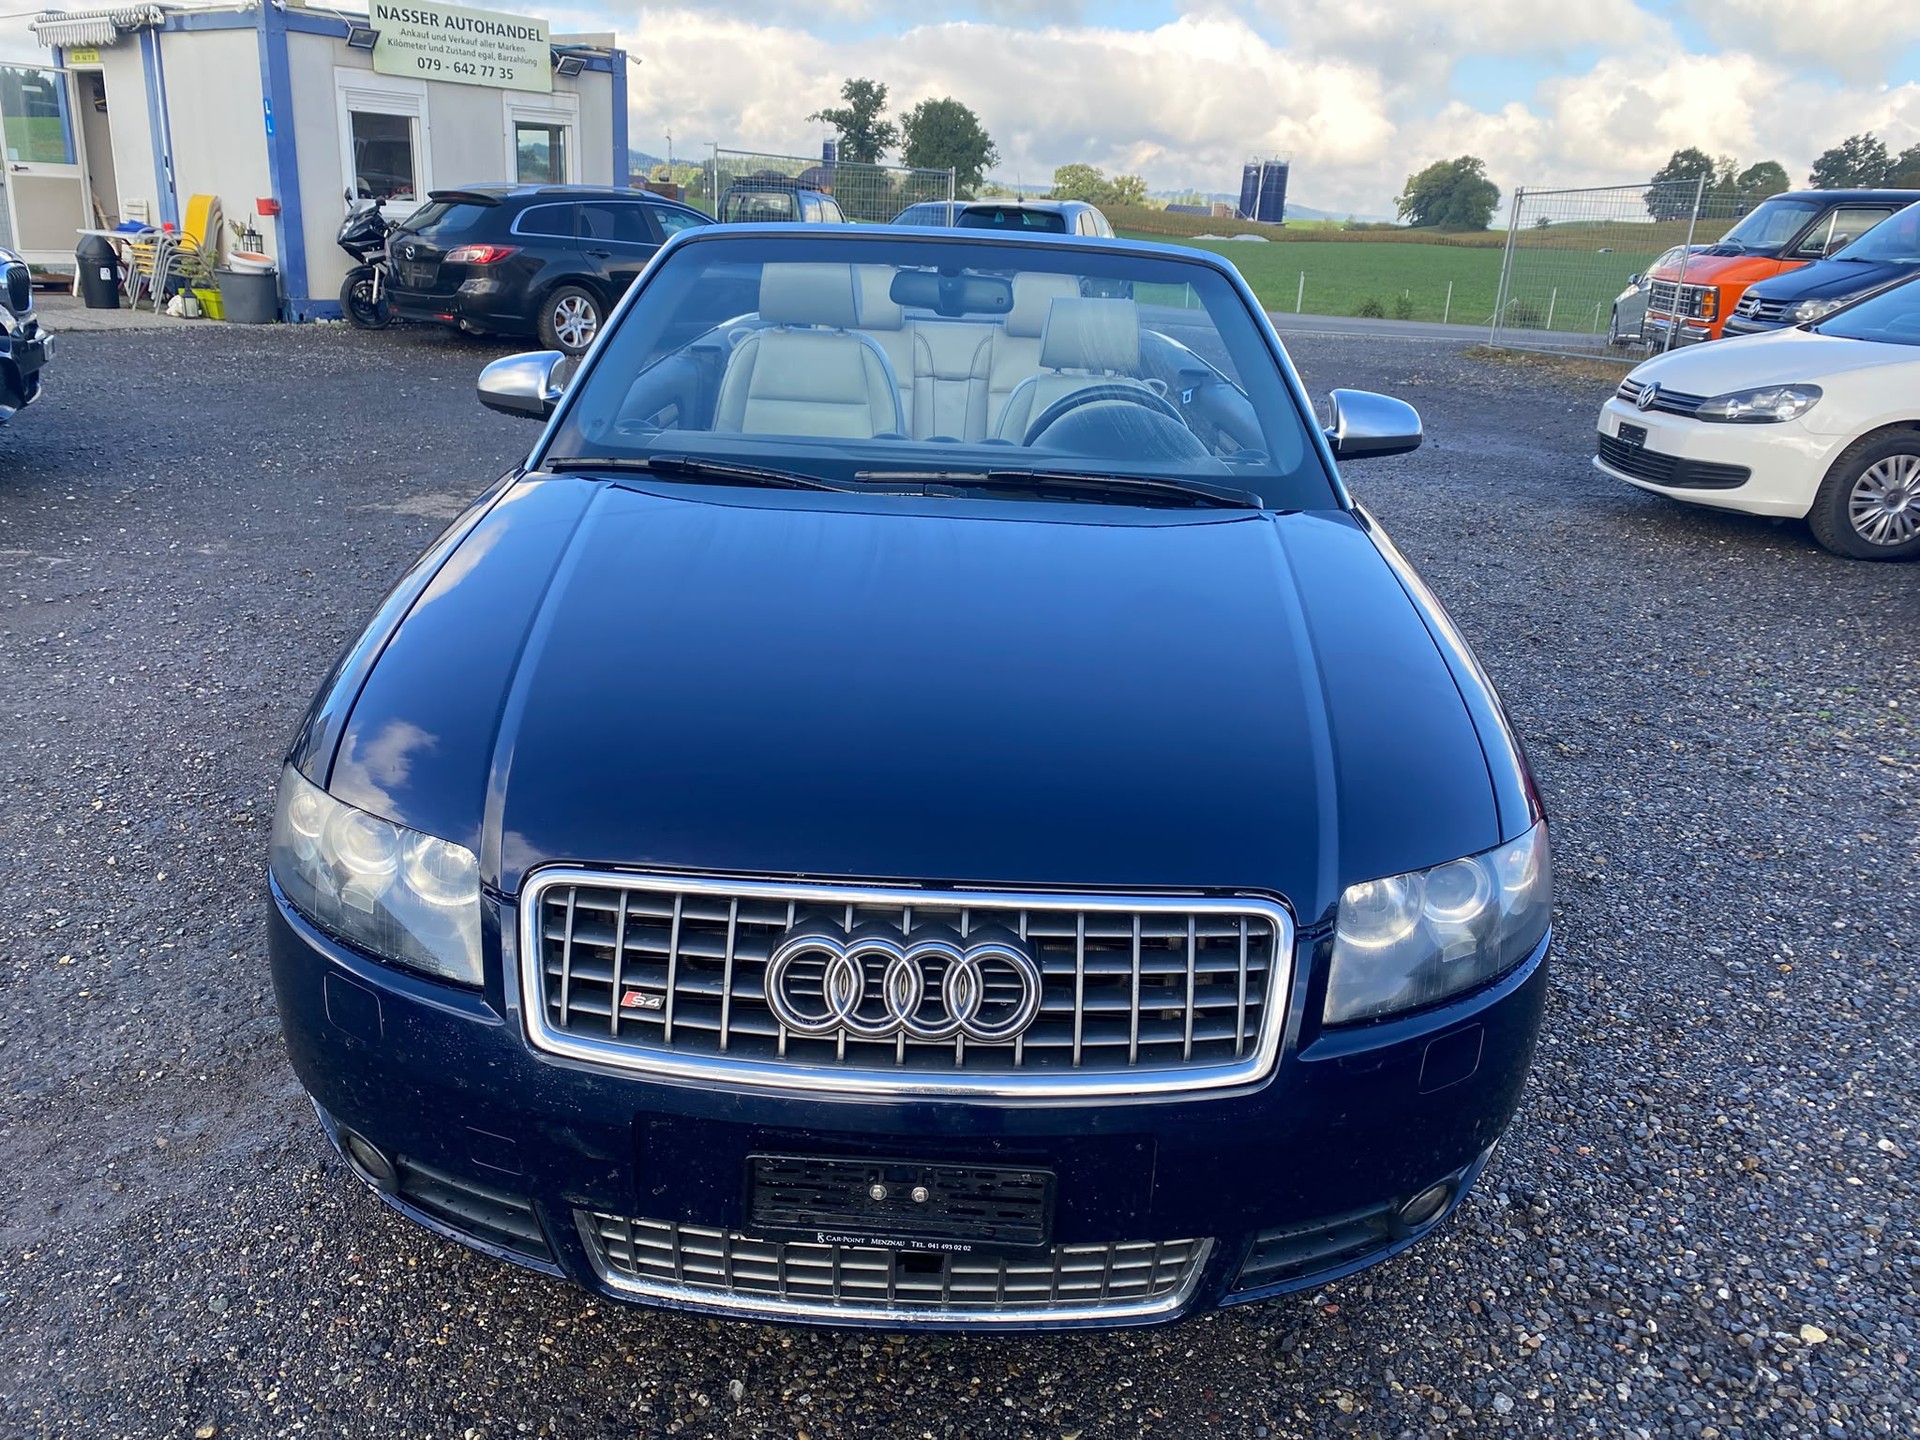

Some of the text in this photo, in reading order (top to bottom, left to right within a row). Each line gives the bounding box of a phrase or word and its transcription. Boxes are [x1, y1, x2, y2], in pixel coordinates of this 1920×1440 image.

[377, 4, 544, 42] NASSER AUTOHANDEL
[387, 38, 538, 67] Kilometer und Zustand egal, Barzahlung
[400, 28, 526, 53] Ankauf und Verkauf aller Marken
[417, 56, 442, 71] 079
[453, 61, 477, 76] 642
[480, 65, 495, 77] 77
[499, 67, 514, 80] 35
[630, 995, 661, 1007] S4
[826, 1234, 865, 1244] CAR-POINT
[870, 1238, 906, 1247] MENZNAU
